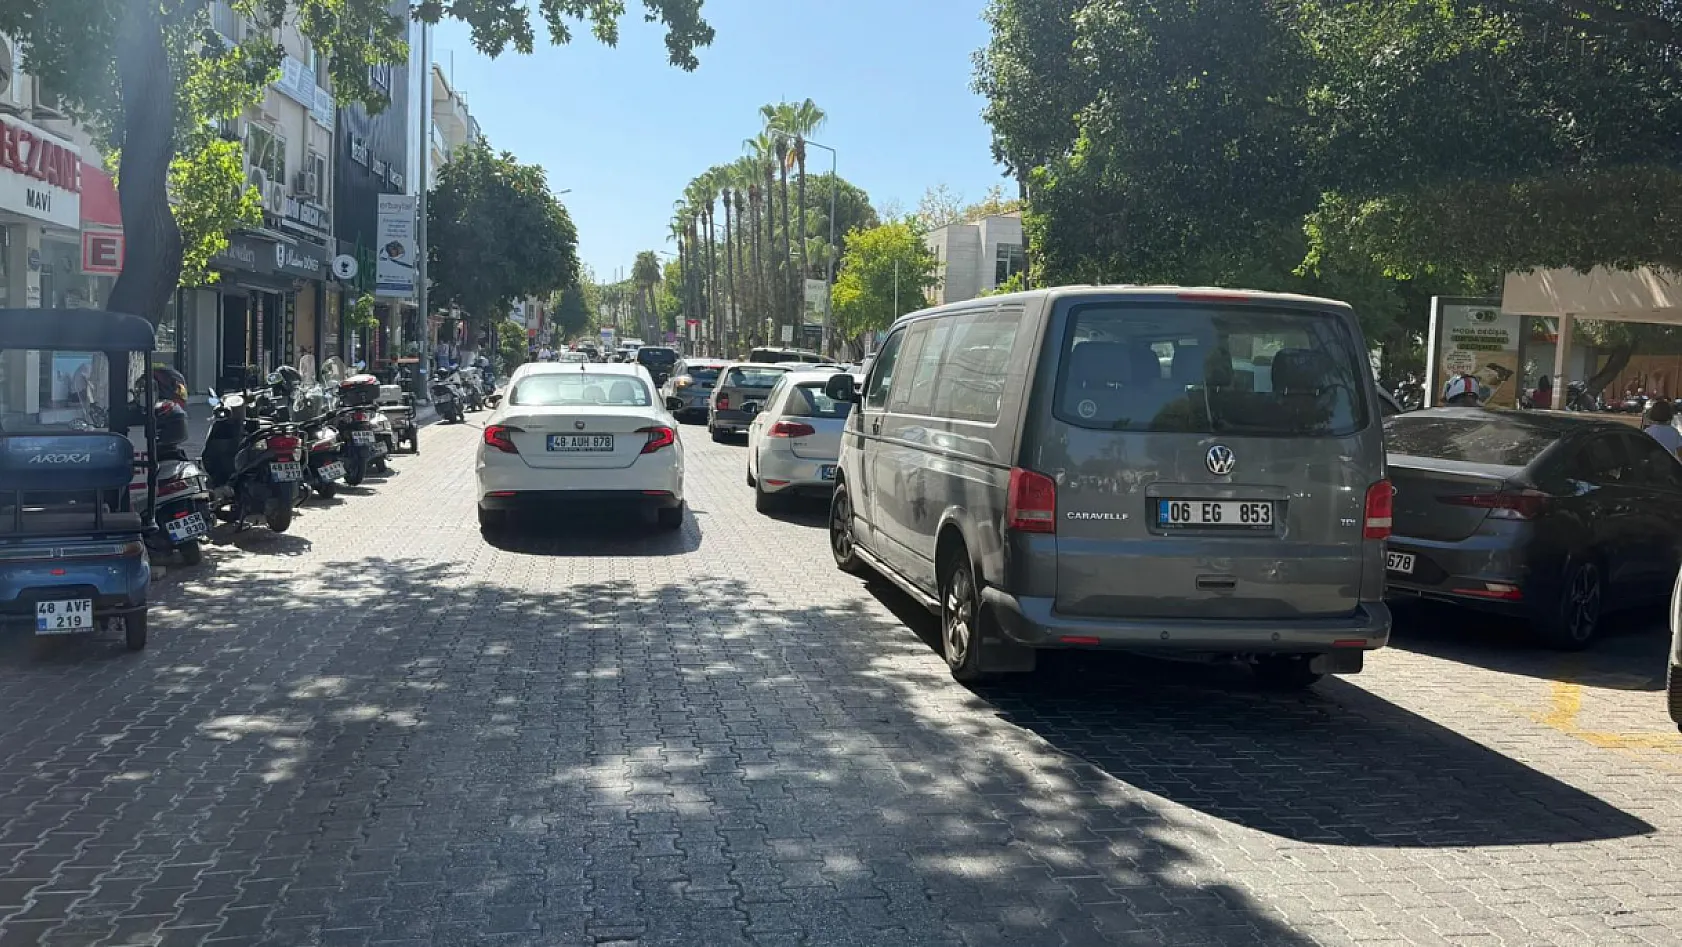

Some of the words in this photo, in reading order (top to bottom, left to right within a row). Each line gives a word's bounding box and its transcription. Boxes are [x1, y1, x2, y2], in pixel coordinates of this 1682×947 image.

[0, 119, 82, 194] ECZANE
[26, 188, 51, 212] MAVİ
[92, 238, 117, 265] E
[554, 437, 566, 447] 48
[571, 437, 589, 447] AUH
[593, 437, 611, 447] 878
[28, 453, 91, 463] ARORA
[1067, 511, 1129, 520] CARAVELLE
[1170, 503, 1190, 521] 06
[1202, 503, 1221, 522] EG
[1240, 503, 1270, 523] 853
[1340, 518, 1356, 527] TDI
[1387, 553, 1411, 570] 678
[38, 602, 55, 614] 48
[66, 600, 91, 612] AVF
[56, 616, 82, 627] 219
